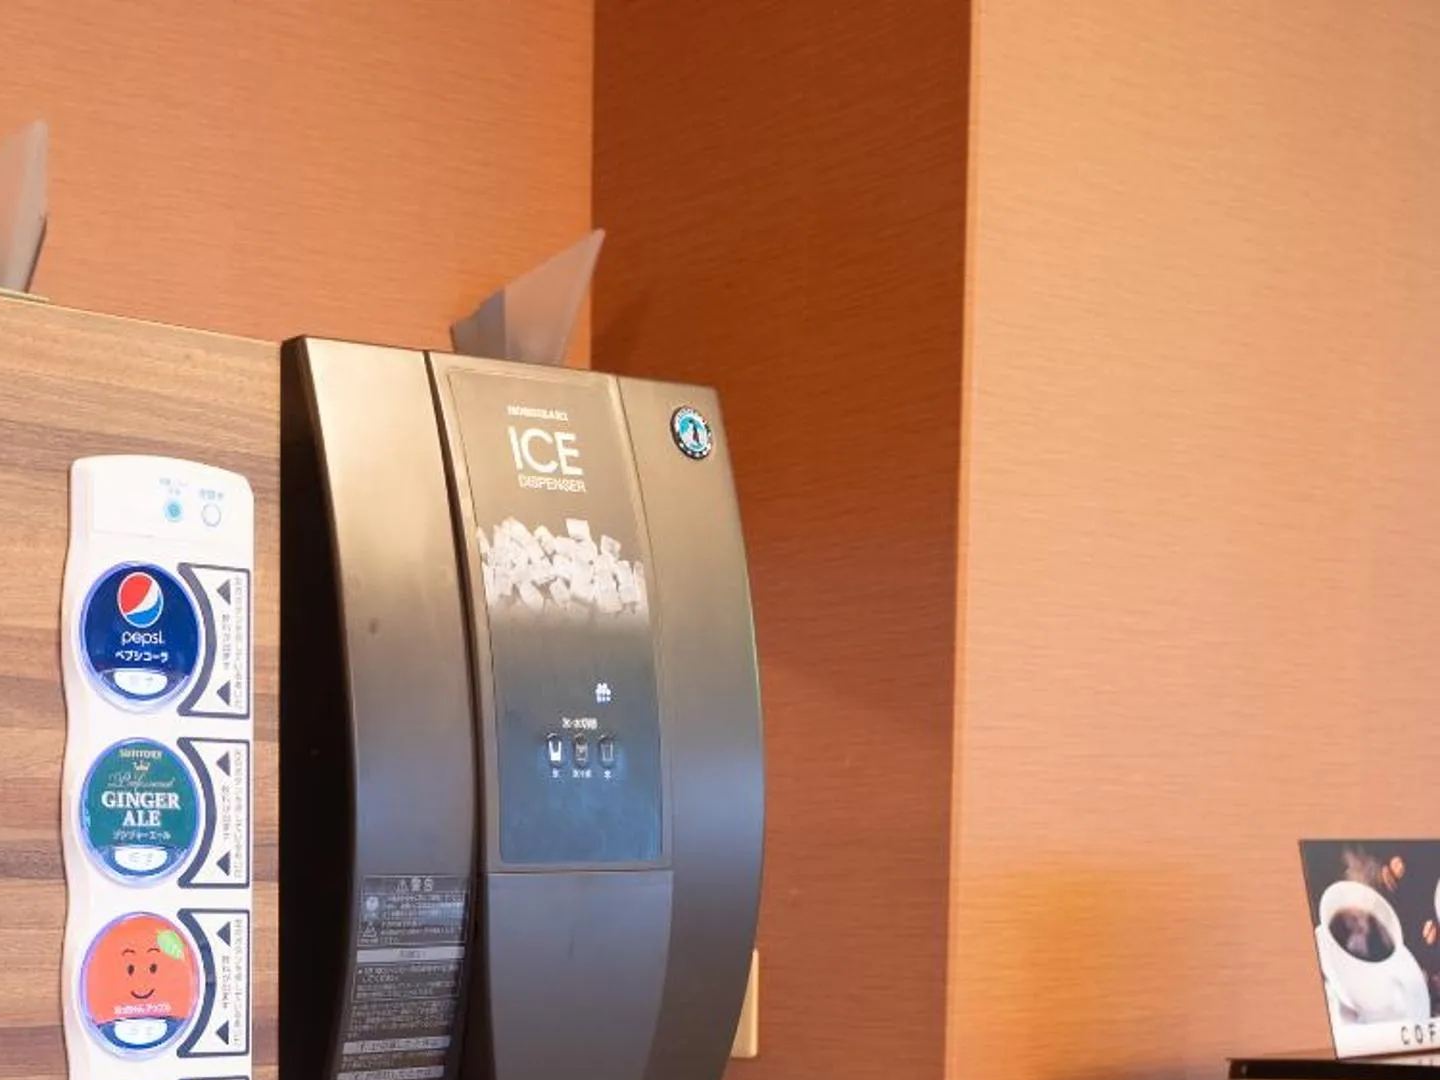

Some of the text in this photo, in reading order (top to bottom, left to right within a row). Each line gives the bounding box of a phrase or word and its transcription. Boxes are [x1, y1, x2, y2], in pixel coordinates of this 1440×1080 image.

[507, 425, 584, 476] ICE
[121, 629, 165, 647] pepsi
[114, 649, 169, 664] ペプシコーラ
[101, 790, 181, 810] GINGER
[122, 809, 162, 827] ALE
